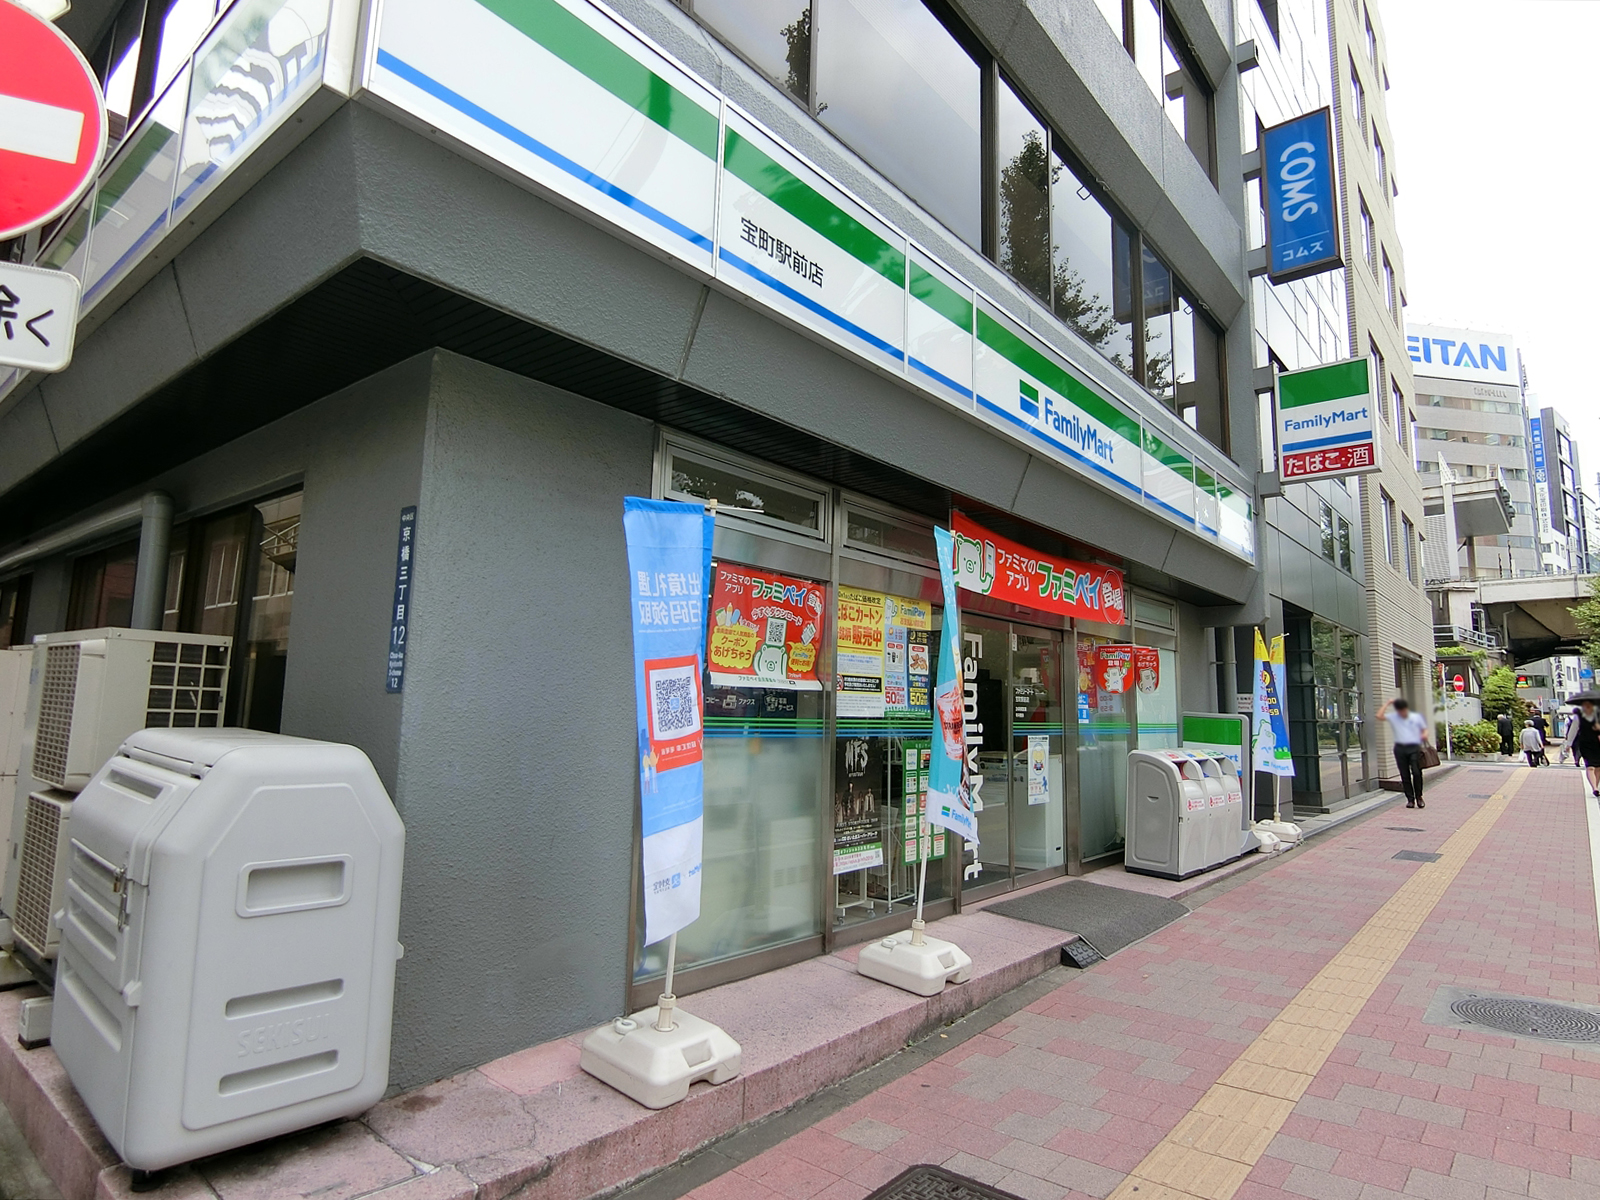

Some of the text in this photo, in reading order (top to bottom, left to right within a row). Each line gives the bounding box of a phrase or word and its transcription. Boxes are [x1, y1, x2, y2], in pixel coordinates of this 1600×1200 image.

[1280, 141, 1318, 222] COMS
[740, 217, 824, 288] 宝町駅前店
[1283, 240, 1324, 261] コムス
[1045, 397, 1113, 463] FamilyMart
[1285, 408, 1368, 431] FamilyMart
[1287, 446, 1369, 475] たばこ・酒
[997, 548, 1037, 575] ファミマの
[393, 526, 412, 645] 京橋三丁目 12
[720, 571, 751, 586] ファミマの
[725, 583, 744, 595] アプリ
[1006, 571, 1030, 591] アプリ
[1037, 561, 1123, 611] ファミペイ 登場
[752, 577, 807, 607] ファミペイ
[900, 604, 926, 619] FamiPay
[721, 636, 748, 647] クーポン
[837, 625, 882, 647] 銘柄販売中
[714, 645, 752, 660] あげちゃう
[1100, 652, 1131, 661] FamiPay
[964, 632, 984, 881] FamilyMrt
[238, 1013, 330, 1058] SEKISUI
